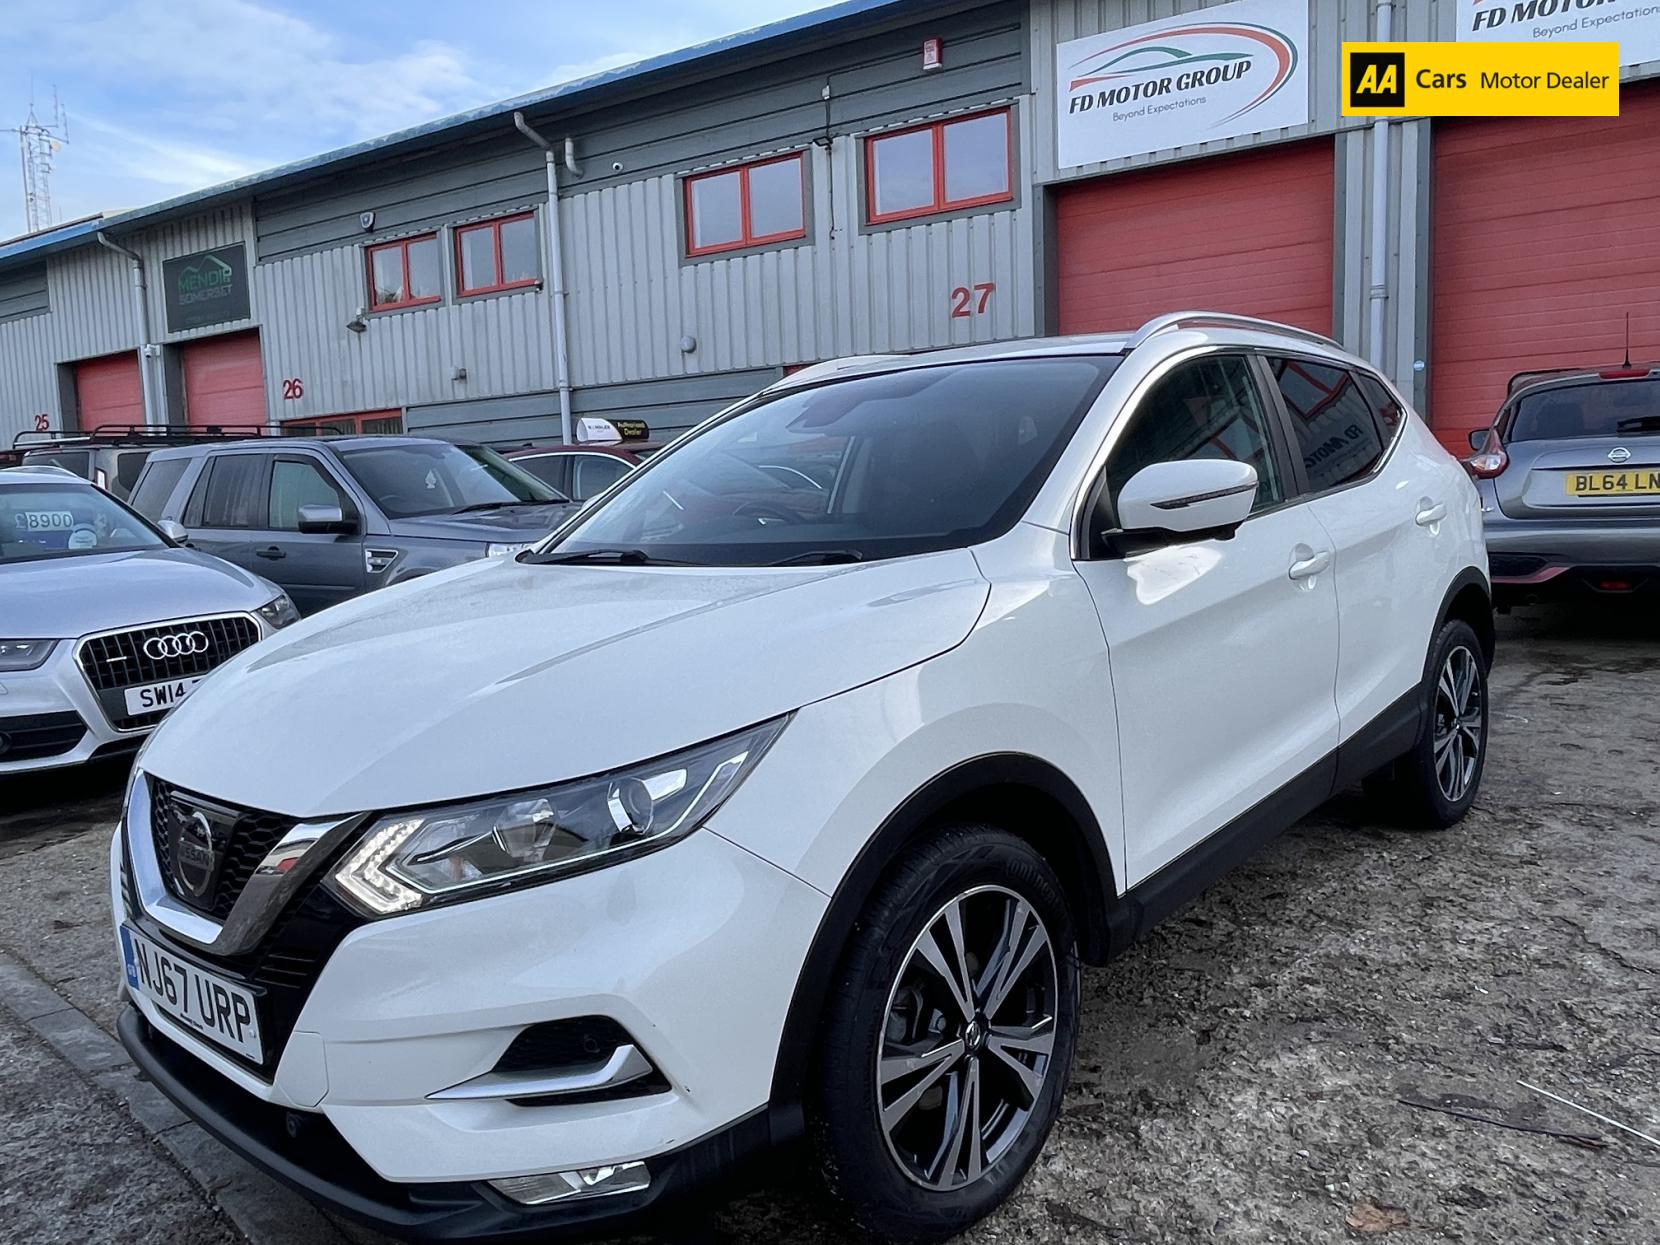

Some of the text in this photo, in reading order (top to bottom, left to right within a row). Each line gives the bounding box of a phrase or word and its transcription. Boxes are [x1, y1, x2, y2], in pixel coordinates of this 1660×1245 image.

[1472, 0, 1616, 31] FD MOT
[1533, 19, 1577, 38] Beyond
[1069, 60, 1251, 114] FD MOTOR GROUP
[1113, 96, 1207, 122] Beyond Expectations
[951, 282, 995, 318] 27
[283, 379, 304, 400] 26
[34, 414, 50, 432] 25
[1576, 473, 1660, 491] BL64 LN
[140, 682, 186, 708] SW14
[135, 939, 250, 1043] NJ67 URP
